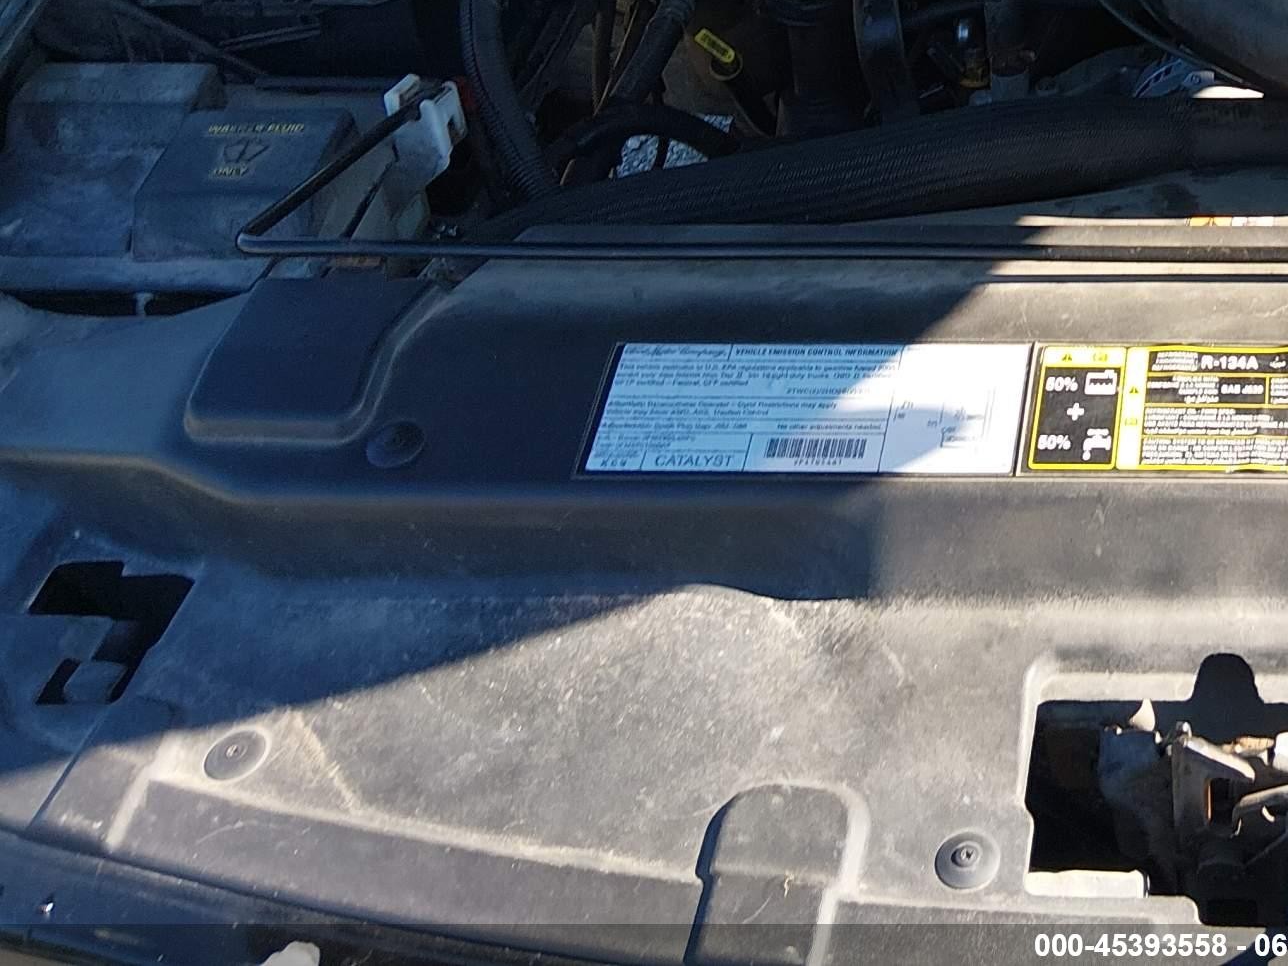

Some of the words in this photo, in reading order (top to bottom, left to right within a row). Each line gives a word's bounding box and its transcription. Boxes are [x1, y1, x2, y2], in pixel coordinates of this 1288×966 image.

[736, 347, 767, 356] VEHICLE
[768, 348, 805, 356] EMISSION
[807, 348, 842, 356] CONTROL
[845, 348, 898, 356] INFORMATION
[1200, 354, 1259, 370] R-134A
[1045, 376, 1079, 392] 50%
[1037, 434, 1071, 450] 50%
[655, 454, 736, 467] CATALYST
